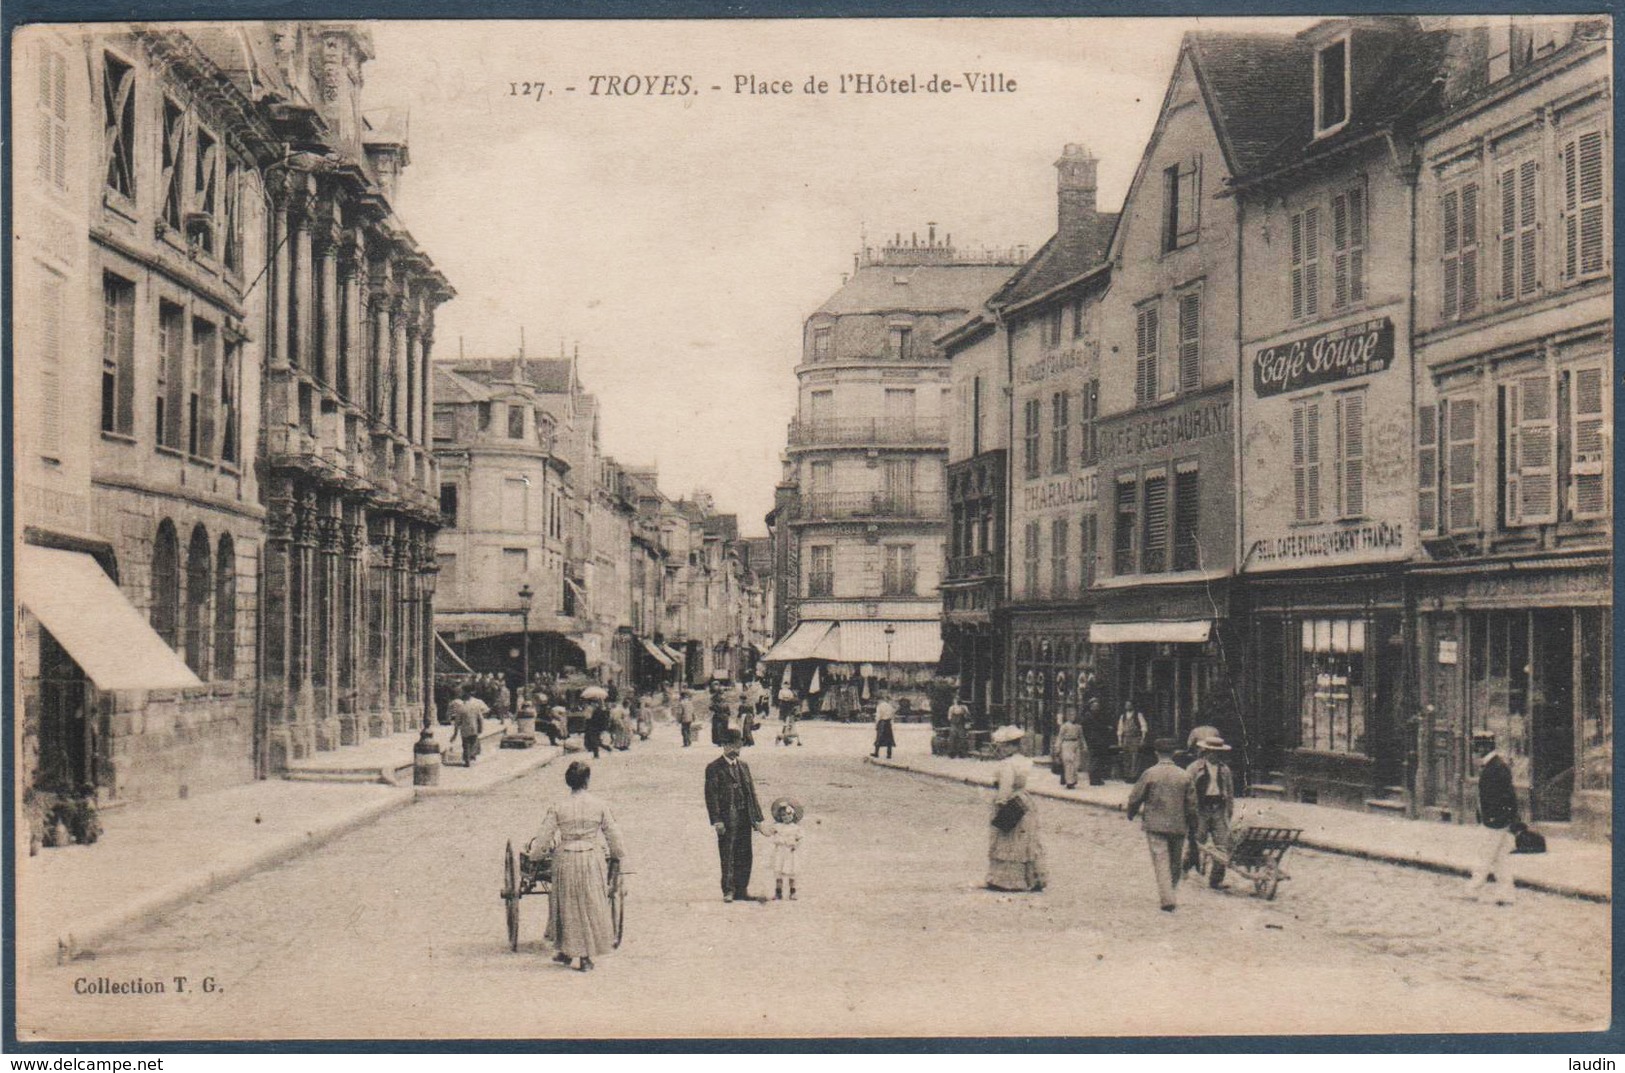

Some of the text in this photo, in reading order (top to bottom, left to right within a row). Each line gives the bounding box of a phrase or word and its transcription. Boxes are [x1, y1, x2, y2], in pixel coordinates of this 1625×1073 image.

[510, 81, 553, 102] 127.
[588, 74, 698, 97] TROYES.
[734, 73, 794, 95] Place
[803, 74, 830, 95] de
[1256, 330, 1379, 391] Café Jouve
[1137, 402, 1230, 454] RESTAURANT
[1024, 474, 1098, 512] PHARMACIE
[74, 976, 225, 995] Collection T. G.
